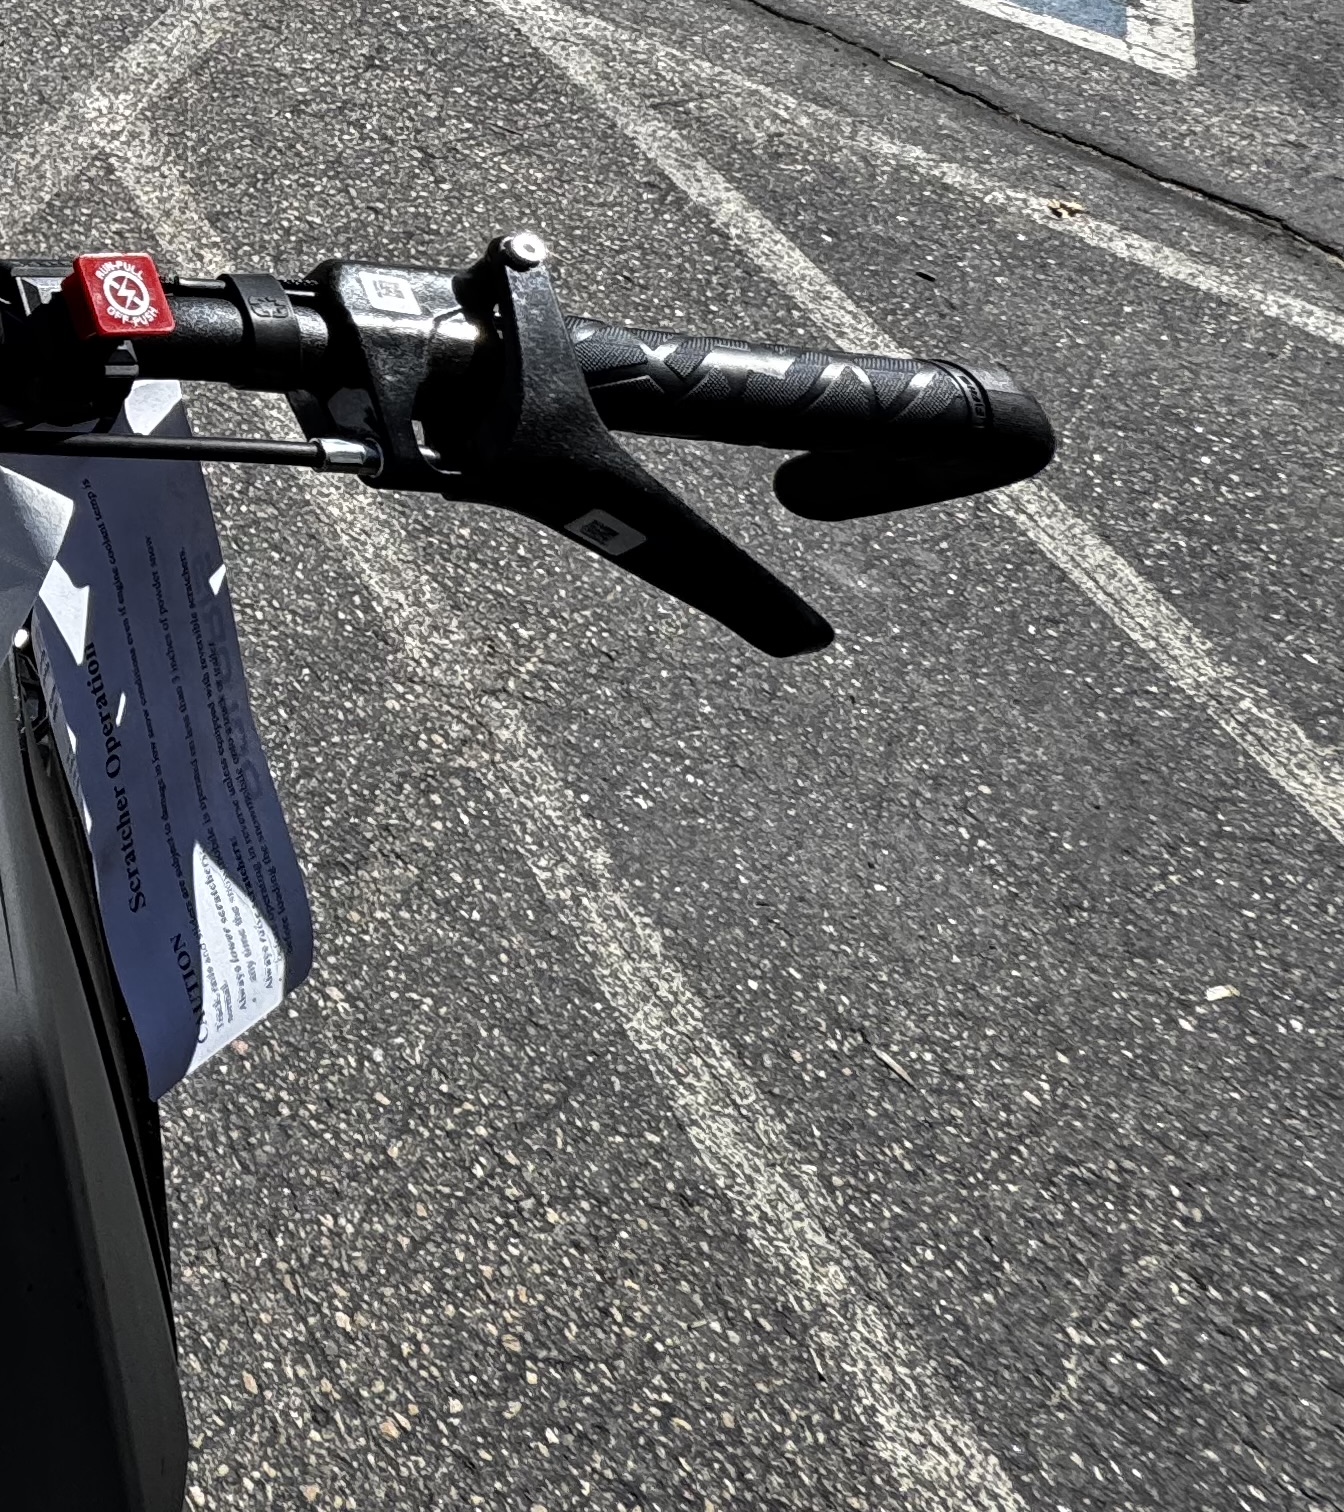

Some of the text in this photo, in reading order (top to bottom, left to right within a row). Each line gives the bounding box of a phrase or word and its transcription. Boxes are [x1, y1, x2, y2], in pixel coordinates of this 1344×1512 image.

[94, 260, 146, 284] RUN-PULL
[105, 303, 160, 331] OFF-PUSH
[81, 478, 90, 490] is
[87, 490, 102, 520] temp
[97, 521, 115, 564] coolant
[145, 535, 157, 568] snow
[111, 565, 125, 604] engine
[151, 570, 168, 614] powder
[179, 546, 196, 609] scratchers.
[122, 617, 133, 645] even
[158, 617, 169, 631] of
[189, 611, 208, 670] reversible
[164, 632, 179, 672] inches
[129, 647, 147, 706] conditions
[201, 671, 213, 698] with
[175, 685, 187, 712] than
[142, 708, 154, 738] snow
[206, 701, 225, 755] equipped
[149, 741, 159, 763] low
[227, 736, 239, 764] onto
[84, 641, 146, 912] Scratcher Operation
[220, 757, 236, 796] unless
[157, 777, 170, 820] damage
[235, 766, 264, 842] snowmobile
[164, 824, 173, 838] to
[231, 799, 253, 844] reverse
[167, 841, 184, 878] subject
[260, 843, 272, 865] the
[178, 879, 188, 898] are
[231, 905, 243, 926] the
[222, 927, 240, 963] lower
[237, 928, 252, 957] time
[245, 959, 258, 982] any
[261, 944, 274, 989] Always
[169, 932, 208, 1040] CAUTION
[233, 964, 248, 1010] Always
